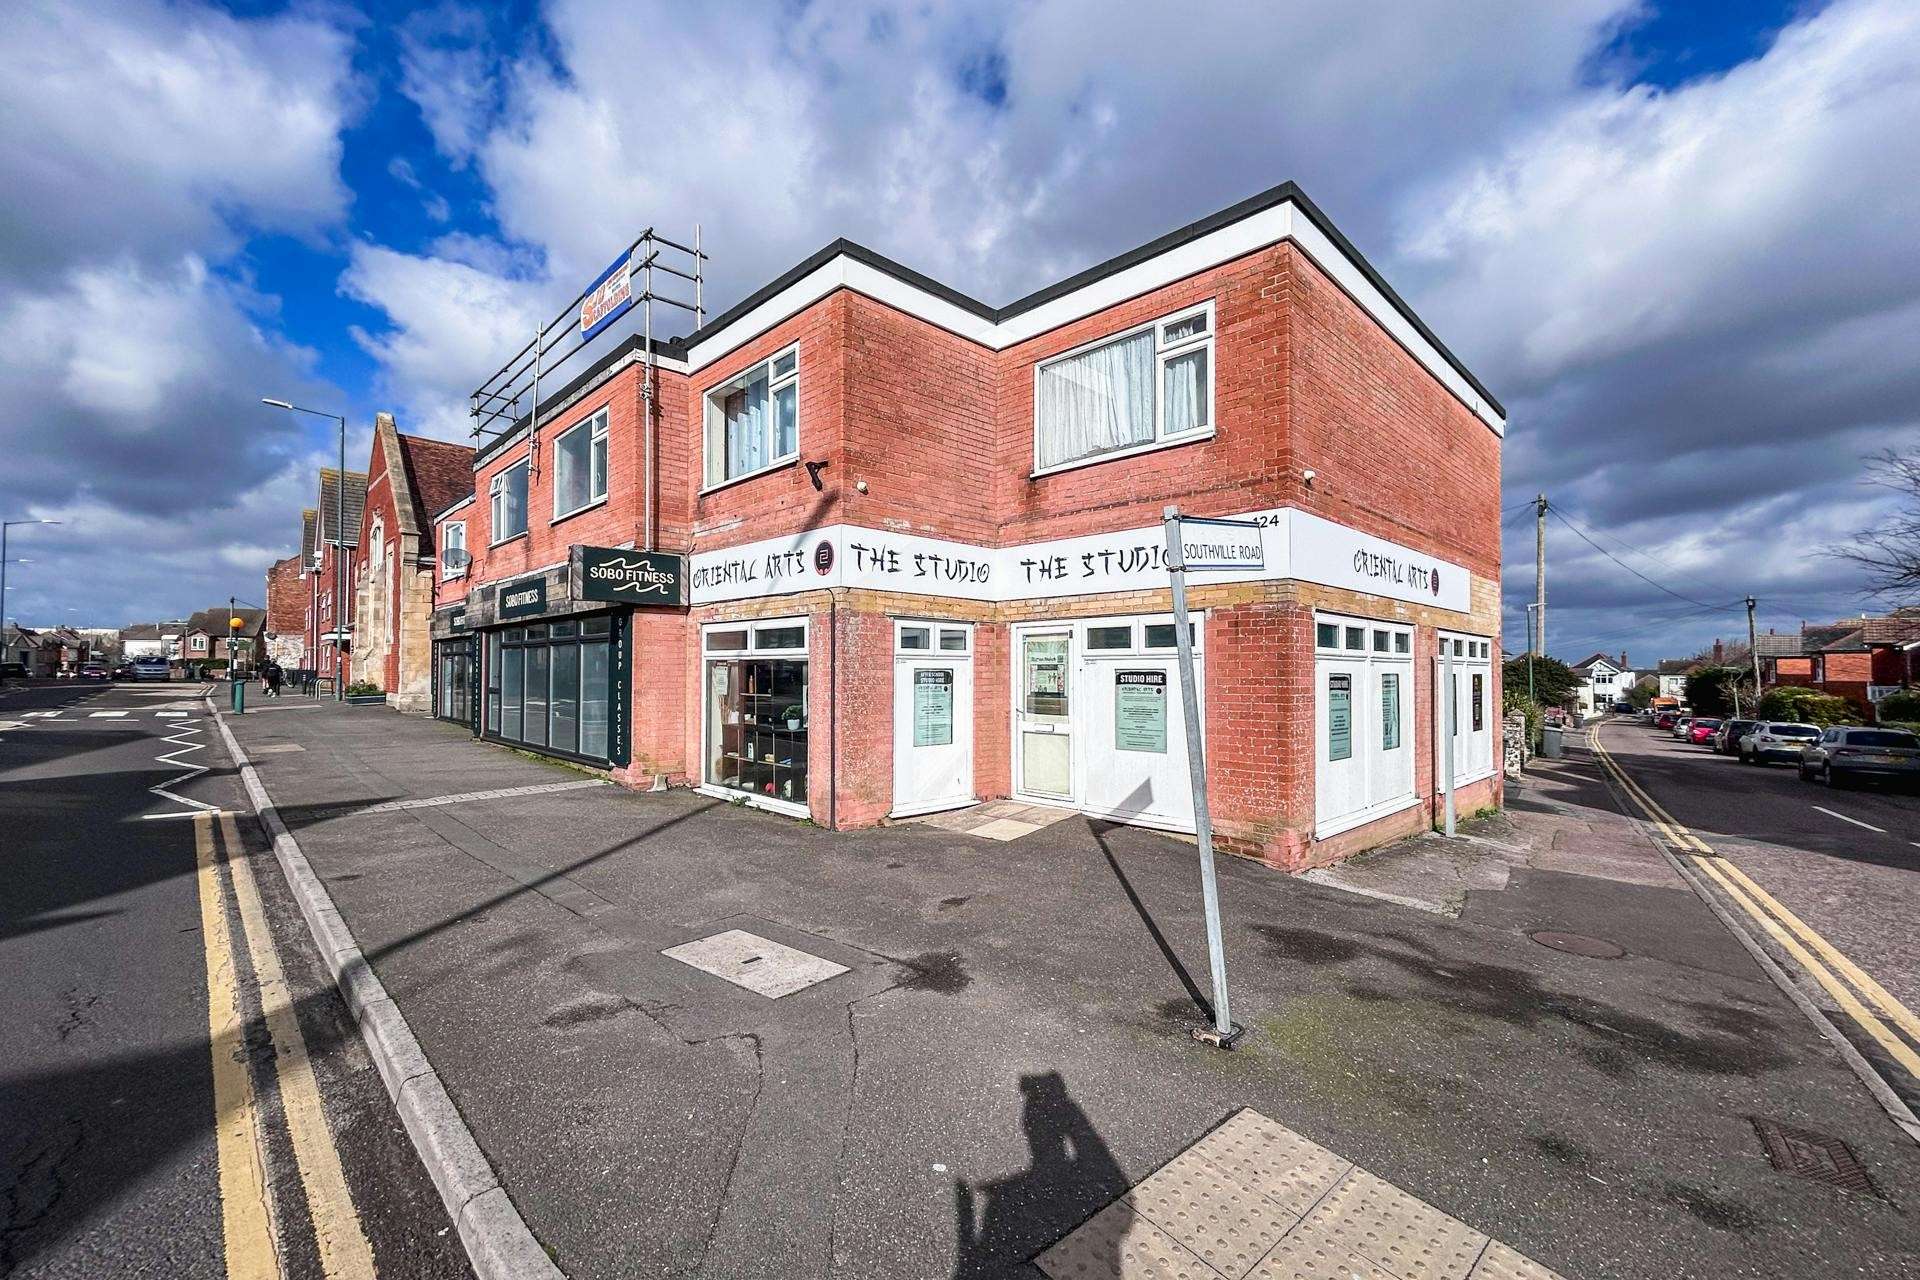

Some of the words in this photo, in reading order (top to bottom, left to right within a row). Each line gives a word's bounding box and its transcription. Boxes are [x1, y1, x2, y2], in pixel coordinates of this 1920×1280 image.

[850, 543, 903, 574] THE
[913, 553, 990, 583] STUDIO
[1183, 543, 1237, 560] SOUTHVILLE
[1239, 545, 1261, 560] ROAD
[590, 566, 624, 580] SOBO
[625, 570, 675, 584] FITNESS
[692, 558, 758, 589] ORIENTAL
[764, 549, 805, 579] ARTS
[1020, 555, 1069, 583] THE
[1353, 548, 1403, 584] ORIENTAL
[1408, 563, 1428, 589] ARTS
[1120, 674, 1145, 683] STUDIO
[1146, 675, 1163, 683] HIRE
